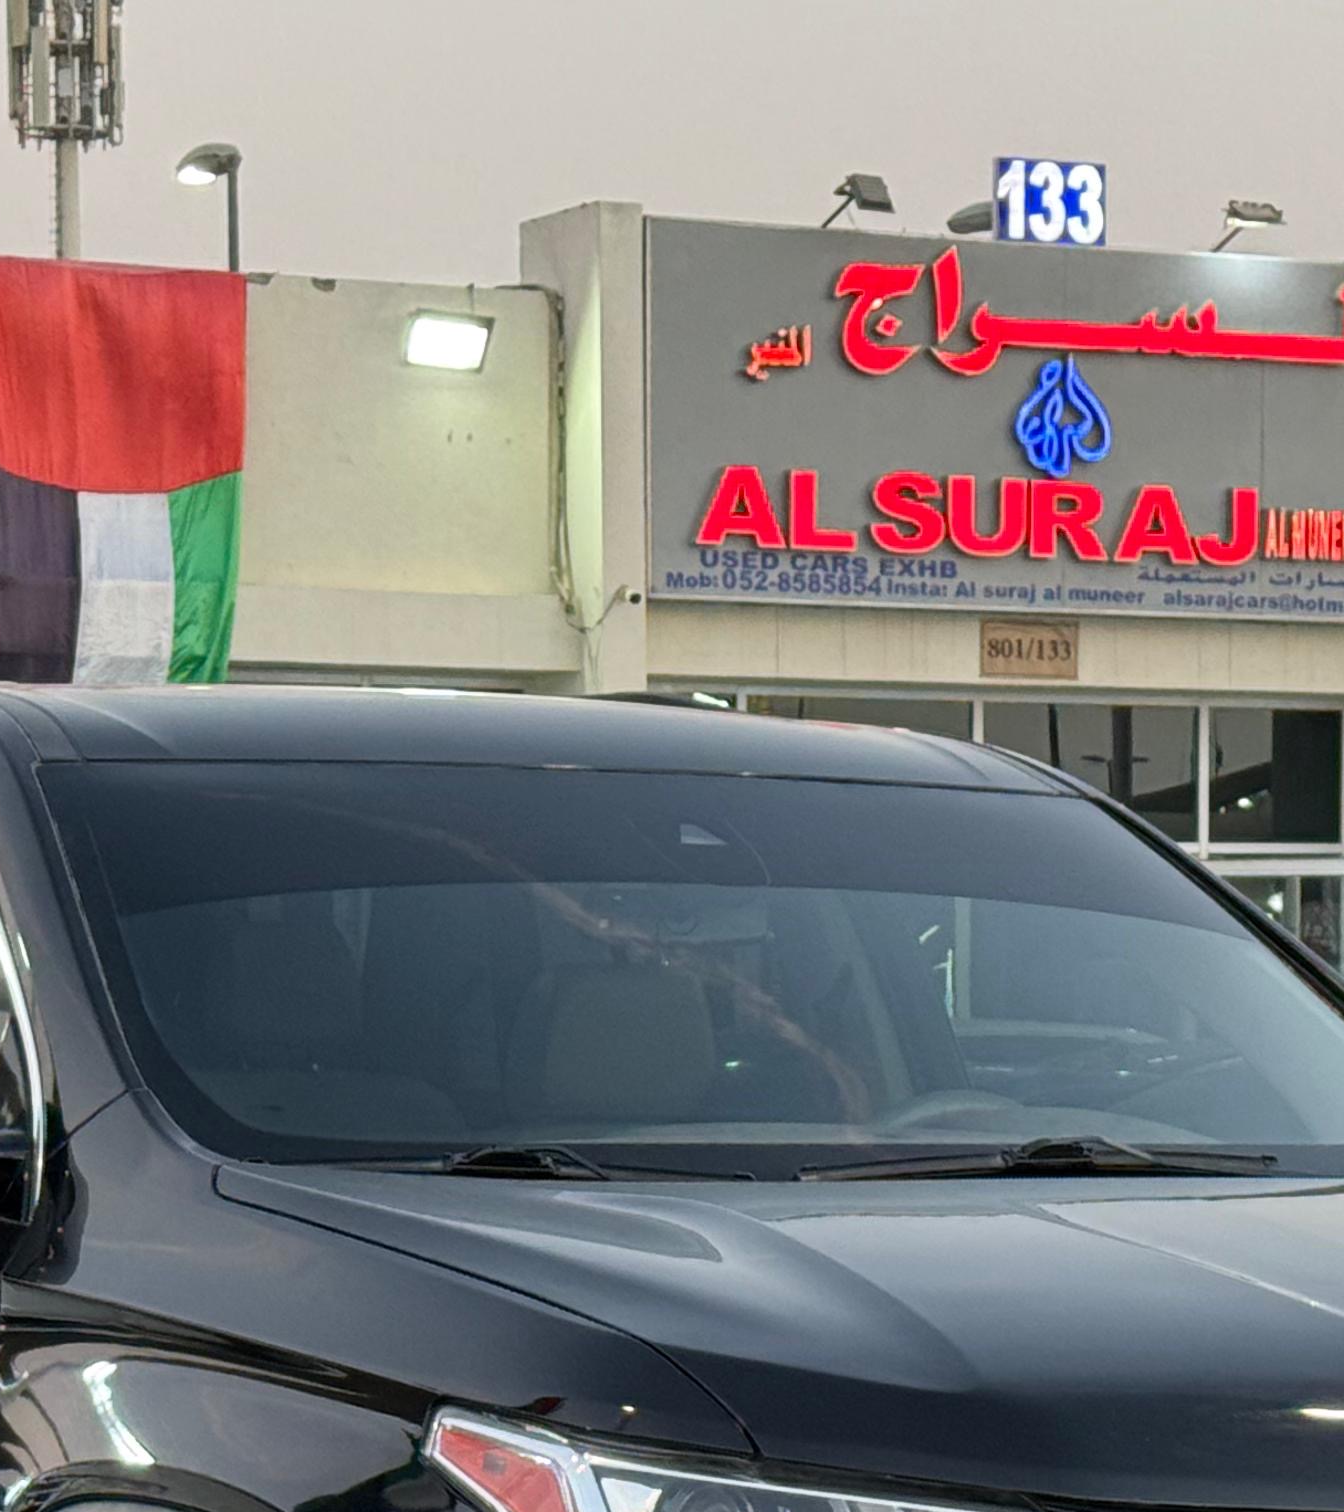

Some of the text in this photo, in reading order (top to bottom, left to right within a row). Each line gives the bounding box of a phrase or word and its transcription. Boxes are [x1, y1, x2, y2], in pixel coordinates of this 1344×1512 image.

[997, 159, 1105, 245] 133
[695, 464, 1260, 567] AL SURAJ
[1264, 507, 1289, 559] AL
[699, 548, 958, 579] USED CARS EXHB
[666, 571, 719, 589] Mob:
[722, 568, 882, 596] 052-8585854
[887, 578, 948, 598] Insta:
[955, 580, 976, 598] Al
[983, 583, 1037, 604] suraj
[1043, 585, 1062, 601] al
[1067, 587, 1146, 605] muneer
[987, 637, 1072, 661] 801/133
